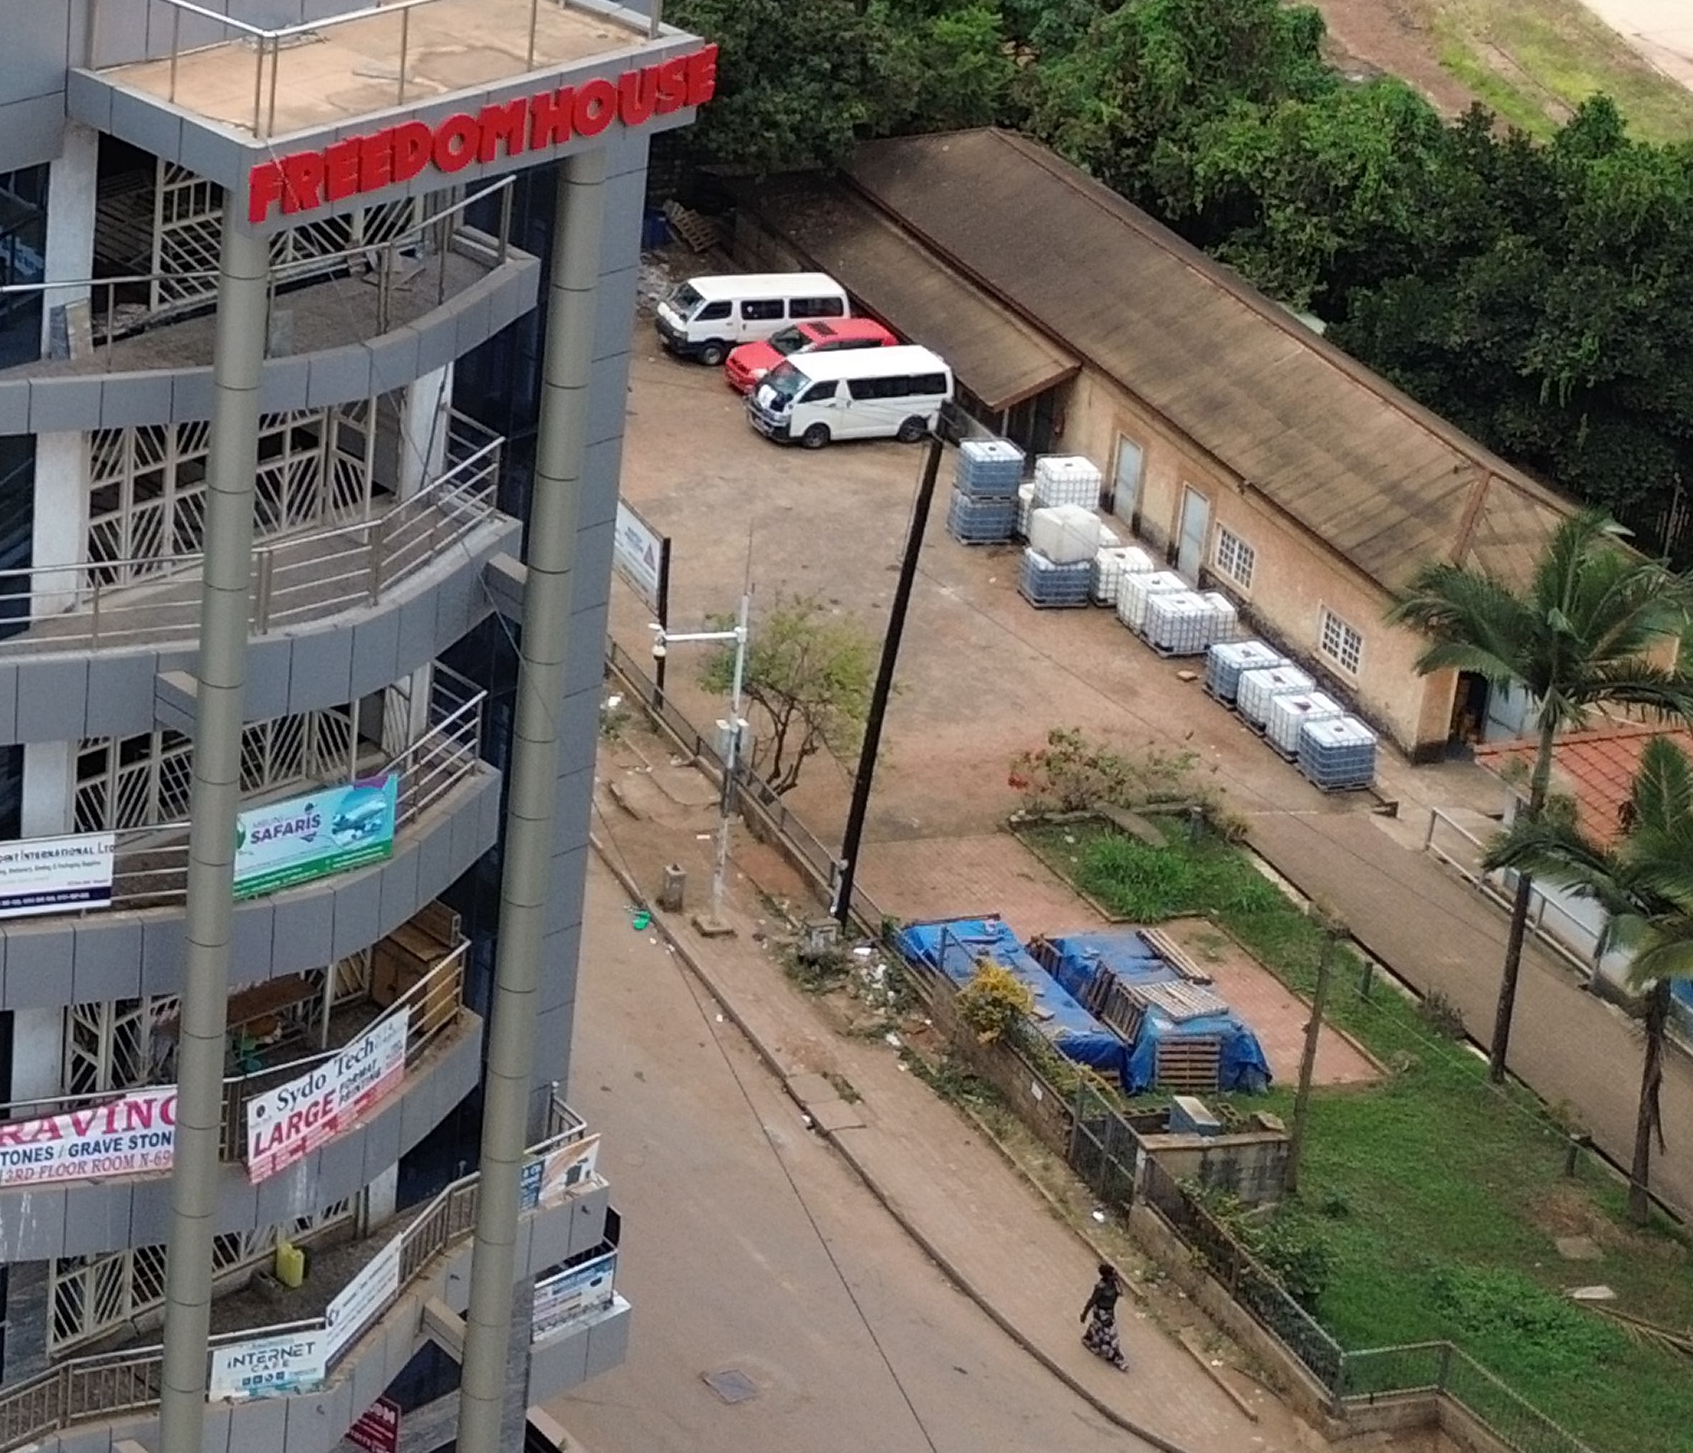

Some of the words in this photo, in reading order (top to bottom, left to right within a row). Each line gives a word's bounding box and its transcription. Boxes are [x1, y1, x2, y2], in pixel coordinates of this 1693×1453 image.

[248, 97, 526, 223] FREEDOM
[529, 43, 718, 152] HOUSE
[250, 813, 322, 845] SAFARIS
[275, 1072, 327, 1113] Sydo
[333, 1035, 375, 1078] Tech
[68, 1134, 123, 1158] GRAVE
[128, 1130, 172, 1150] STON
[253, 1088, 337, 1160] LARGE
[38, 1160, 87, 1180] FLOOR
